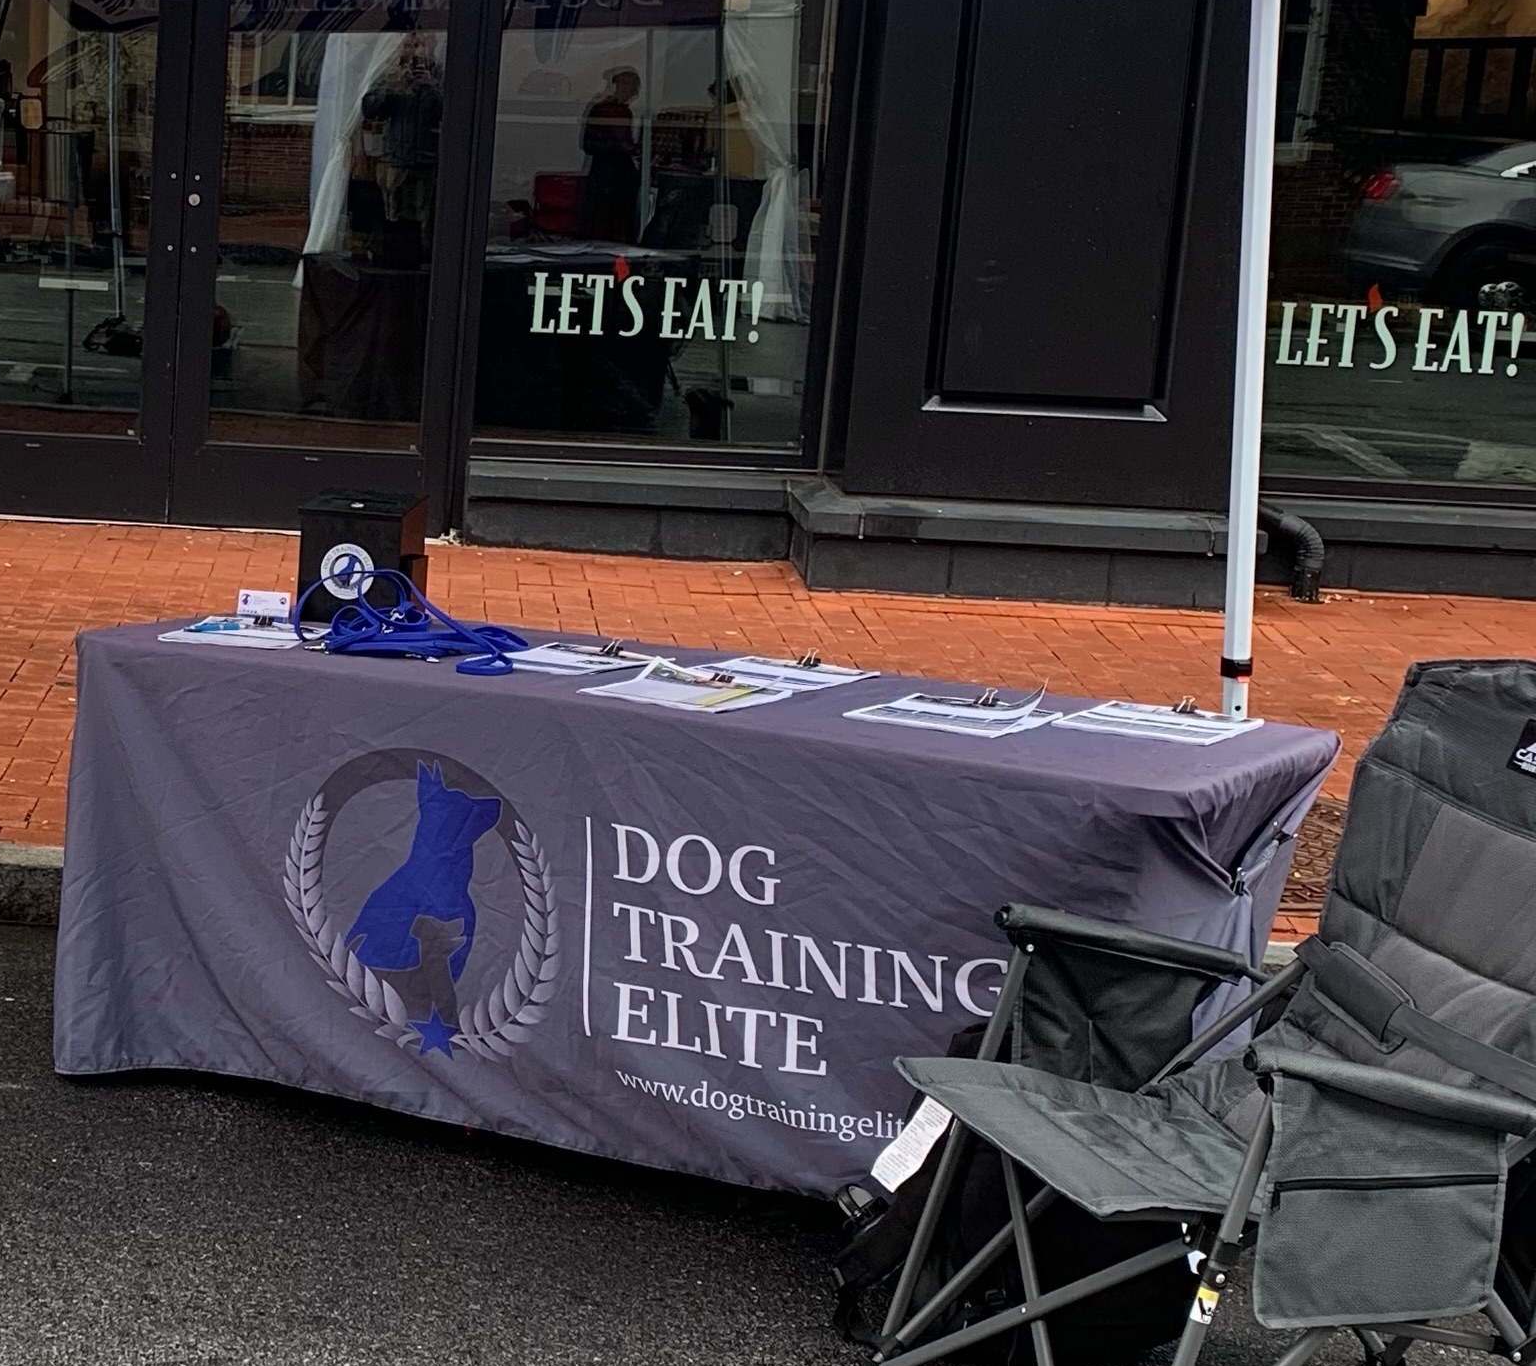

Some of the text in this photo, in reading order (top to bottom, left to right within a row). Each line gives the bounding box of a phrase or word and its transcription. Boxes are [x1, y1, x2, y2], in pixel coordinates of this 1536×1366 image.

[529, 253, 764, 344] LET'S EAT!
[1275, 283, 1526, 378] LET'S EAT!
[611, 823, 781, 905] DOG
[613, 902, 1009, 1017] TRAINING
[611, 982, 827, 1076] ELITE
